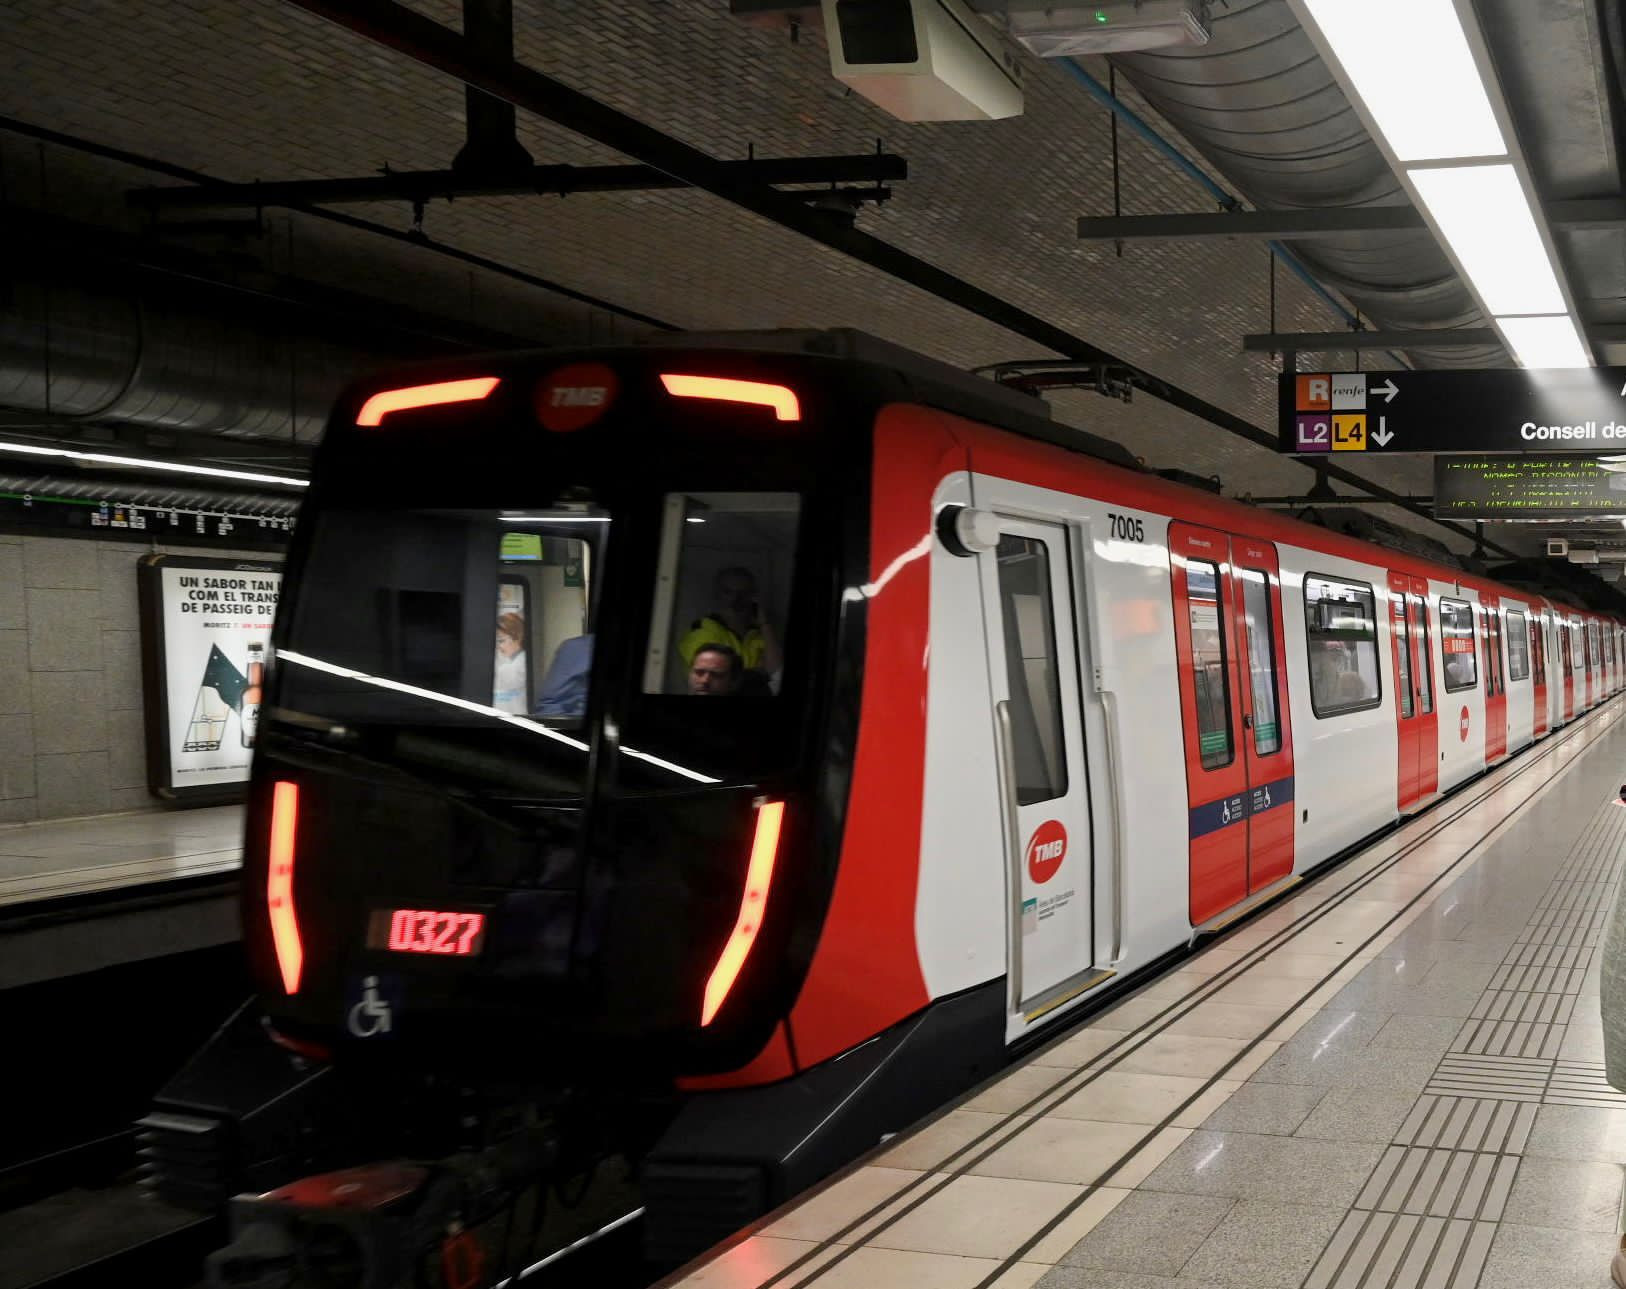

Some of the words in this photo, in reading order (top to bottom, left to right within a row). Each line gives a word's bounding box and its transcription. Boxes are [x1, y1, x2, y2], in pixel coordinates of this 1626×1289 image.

[1309, 380, 1328, 400] R
[1299, 423, 1328, 443] L2
[1334, 422, 1363, 442] L4
[1521, 421, 1596, 440] Consell
[1108, 513, 1144, 542] 7005
[180, 577, 199, 588] UN
[204, 578, 247, 590] SABOR
[251, 581, 274, 591] TAN
[189, 590, 219, 601] COM
[224, 592, 237, 602] EL
[182, 603, 198, 613] DE
[202, 603, 253, 615] PASSEIG
[258, 606, 272, 615] DE
[1035, 840, 1063, 864] TMB
[389, 909, 485, 954] 0327
